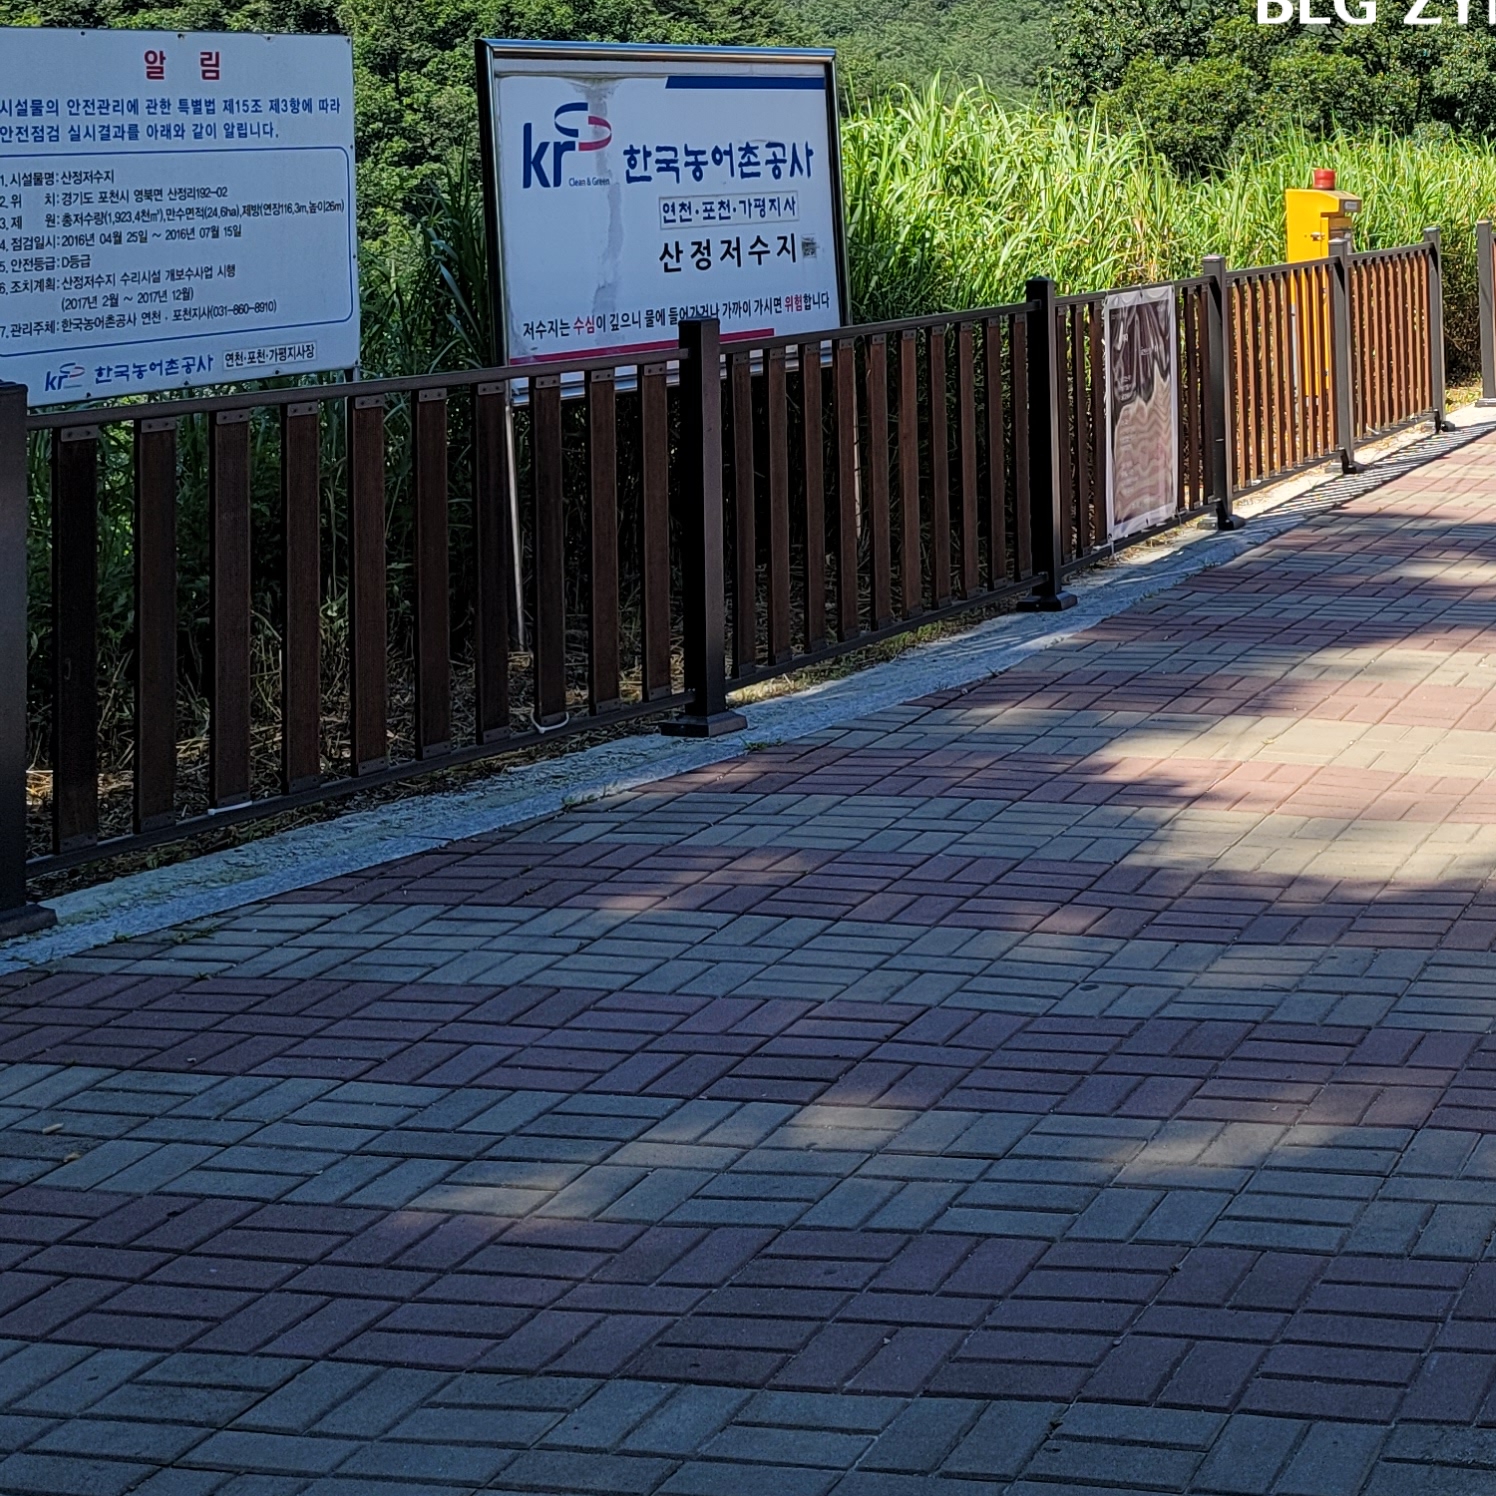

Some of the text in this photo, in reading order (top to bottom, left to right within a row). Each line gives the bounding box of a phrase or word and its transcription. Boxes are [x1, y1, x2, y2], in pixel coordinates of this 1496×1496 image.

[0, 97, 341, 117] 시설물의 안전관리에 관한 특별법 제15조 제3항에 따라
[0, 121, 279, 143] 안전점검 실시결과를 아래와 같이 알립니다.
[623, 141, 814, 184] 한국농어촌공사
[98, 189, 130, 204] 포천시
[133, 188, 163, 203] 영북면
[99, 231, 122, 245] 04월
[126, 229, 148, 244] 25일
[165, 226, 195, 241] 2016년
[199, 225, 219, 239] 07월
[224, 224, 242, 238] 15일
[659, 232, 797, 273] 산정저수지
[120, 269, 161, 286] 수리시설
[102, 293, 119, 308] 2월
[137, 289, 168, 304] 2017년
[141, 310, 161, 326] 연천
[523, 318, 571, 340] 저수지는
[573, 314, 606, 335] 수심이
[609, 310, 642, 332] 깊으니
[644, 308, 666, 328] 물에
[722, 299, 751, 320] 가까이
[754, 296, 782, 317] 가시면
[784, 291, 830, 313] 위험합니다
[94, 355, 214, 385] 한국농어촌공사
